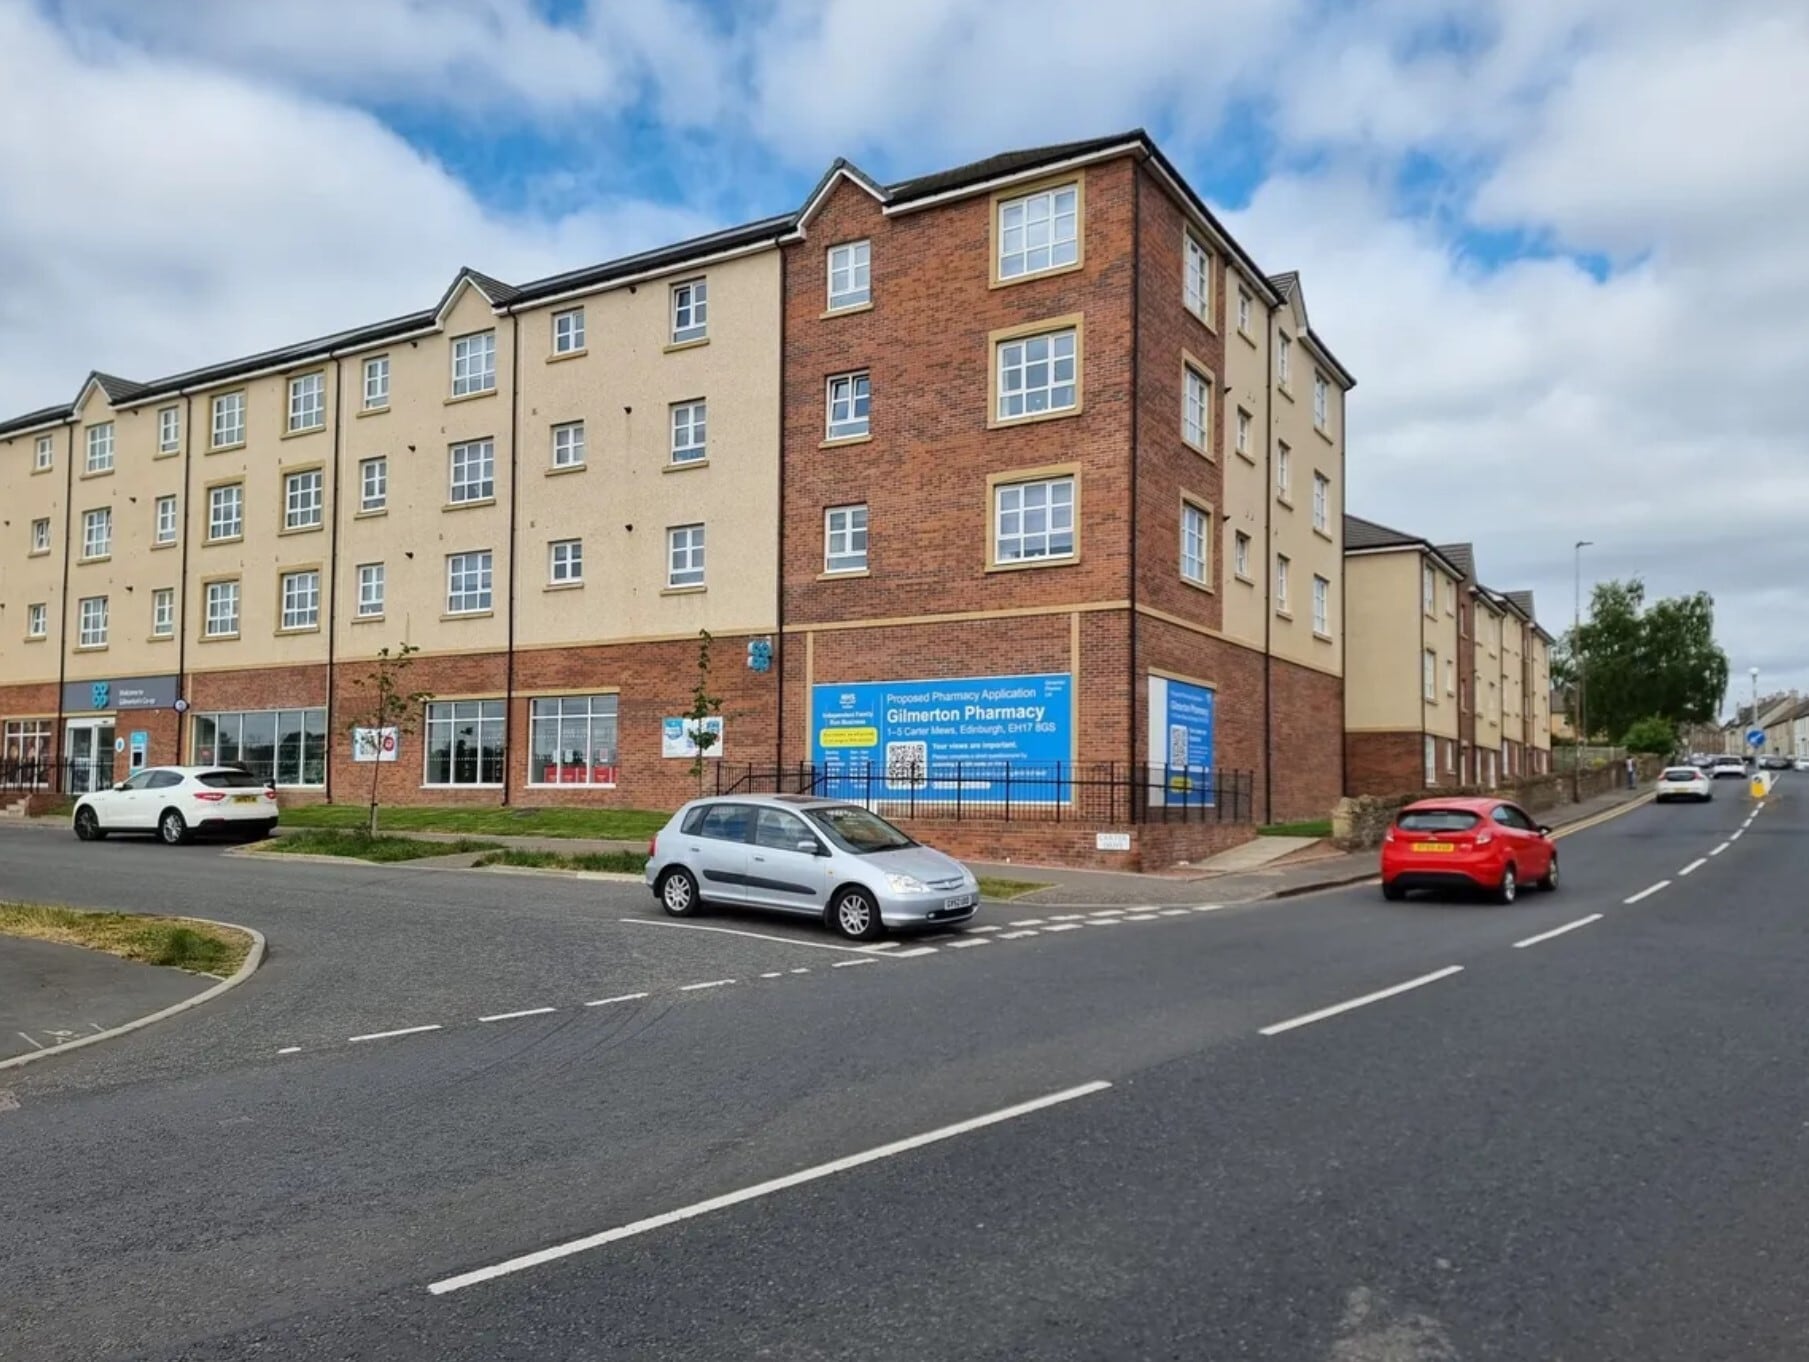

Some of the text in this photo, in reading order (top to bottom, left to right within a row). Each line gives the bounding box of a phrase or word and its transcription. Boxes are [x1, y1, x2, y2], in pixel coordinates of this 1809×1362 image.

[886, 693, 930, 705] Proposed
[932, 691, 980, 703] Pharmacy
[981, 688, 1036, 702] Application
[887, 704, 1045, 723] Gilmerton Pharmacy
[904, 726, 930, 737] Carter
[1007, 722, 1033, 733] EH17
